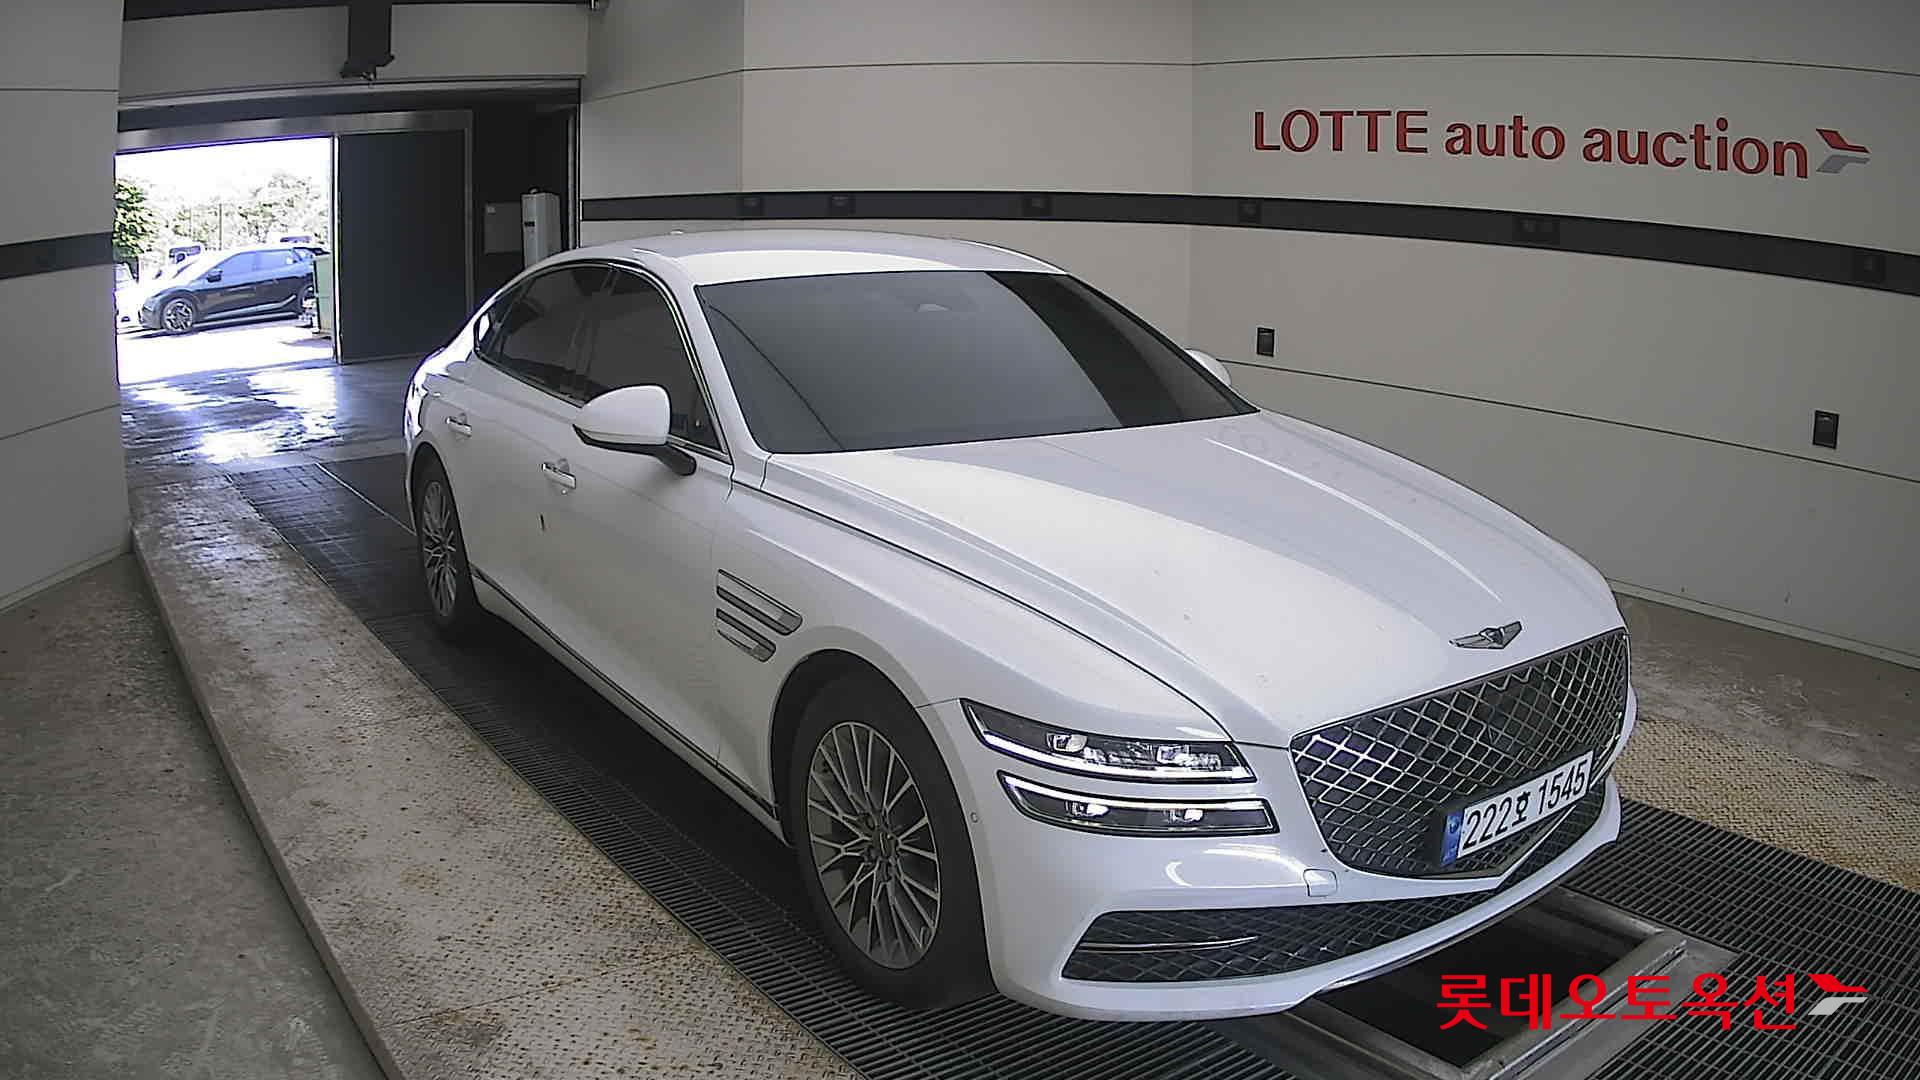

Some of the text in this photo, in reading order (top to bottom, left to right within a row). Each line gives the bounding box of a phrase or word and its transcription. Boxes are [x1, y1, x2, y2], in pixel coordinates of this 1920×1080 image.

[1253, 110, 1809, 179] LOTTE auto auction
[1462, 759, 1588, 850] 222호 1545
